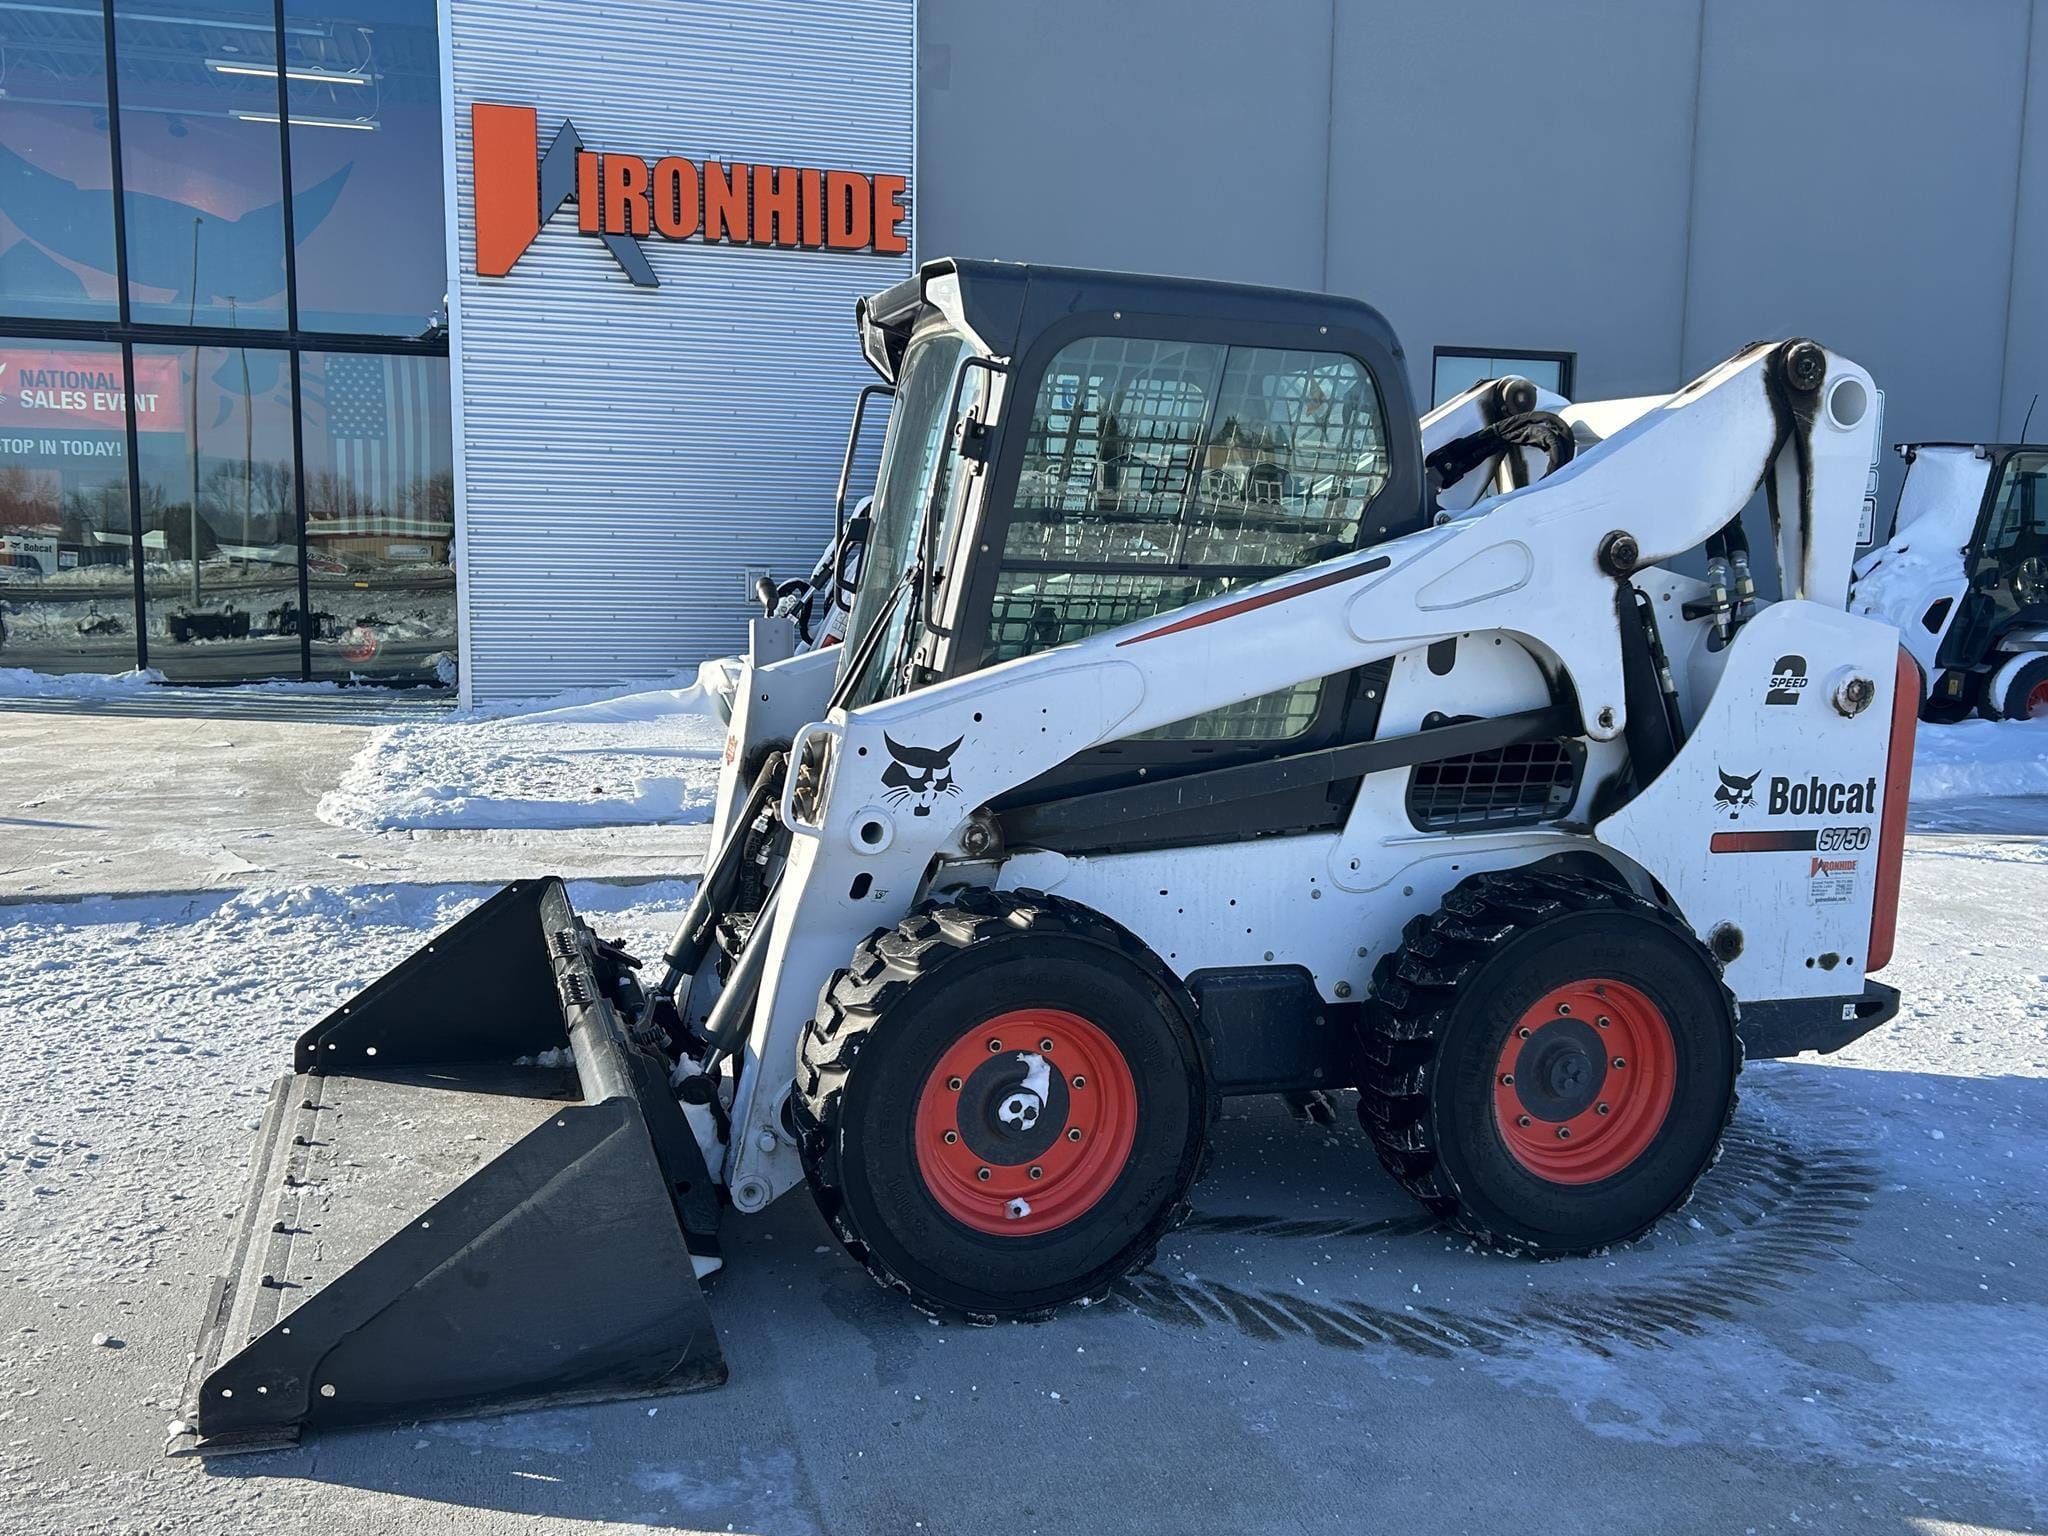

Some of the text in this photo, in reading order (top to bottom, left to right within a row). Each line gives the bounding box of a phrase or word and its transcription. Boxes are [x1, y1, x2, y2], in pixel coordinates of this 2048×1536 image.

[578, 151, 907, 253] IRONHIDE
[20, 369, 121, 390] NATIONAL
[20, 390, 87, 410] SALES
[0, 438, 122, 457] TOP IN TODAY!
[23, 543, 52, 553] Bobcat
[1769, 678, 1808, 688] SPEED
[1768, 776, 1876, 815] Bobcat
[1818, 827, 1871, 851] S750
